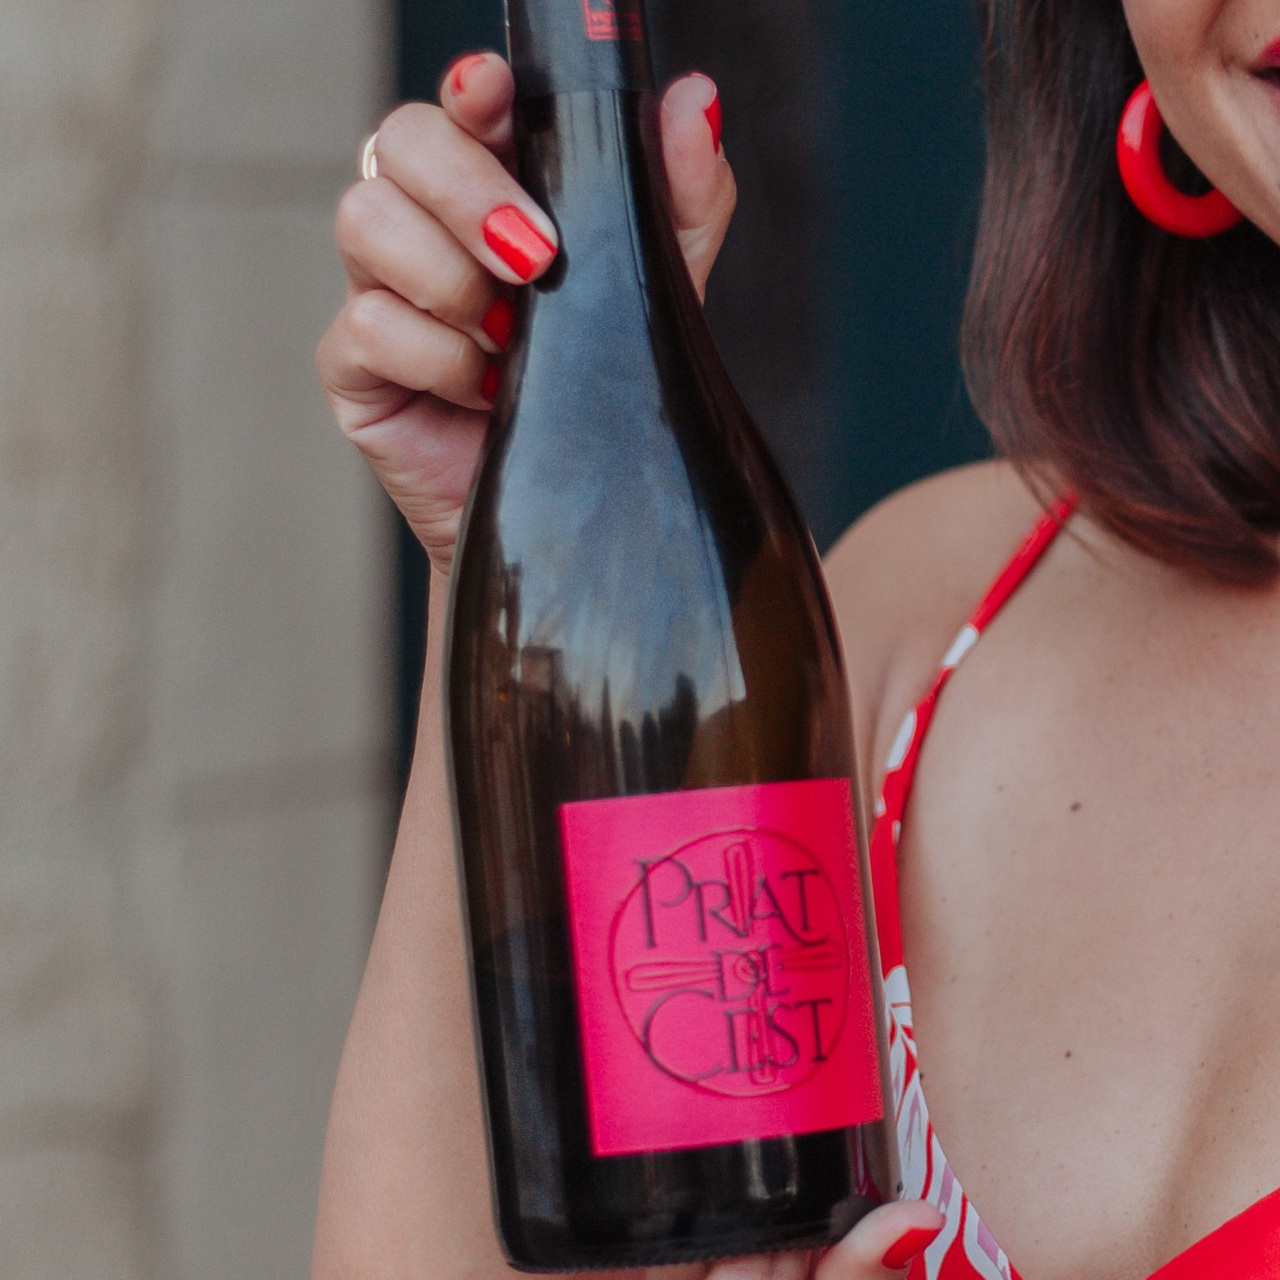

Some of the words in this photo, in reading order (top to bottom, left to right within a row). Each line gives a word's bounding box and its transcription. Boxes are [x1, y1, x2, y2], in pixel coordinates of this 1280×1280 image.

[634, 857, 829, 948] PRAT
[713, 946, 790, 1002] DE
[642, 989, 832, 1082] CEST
